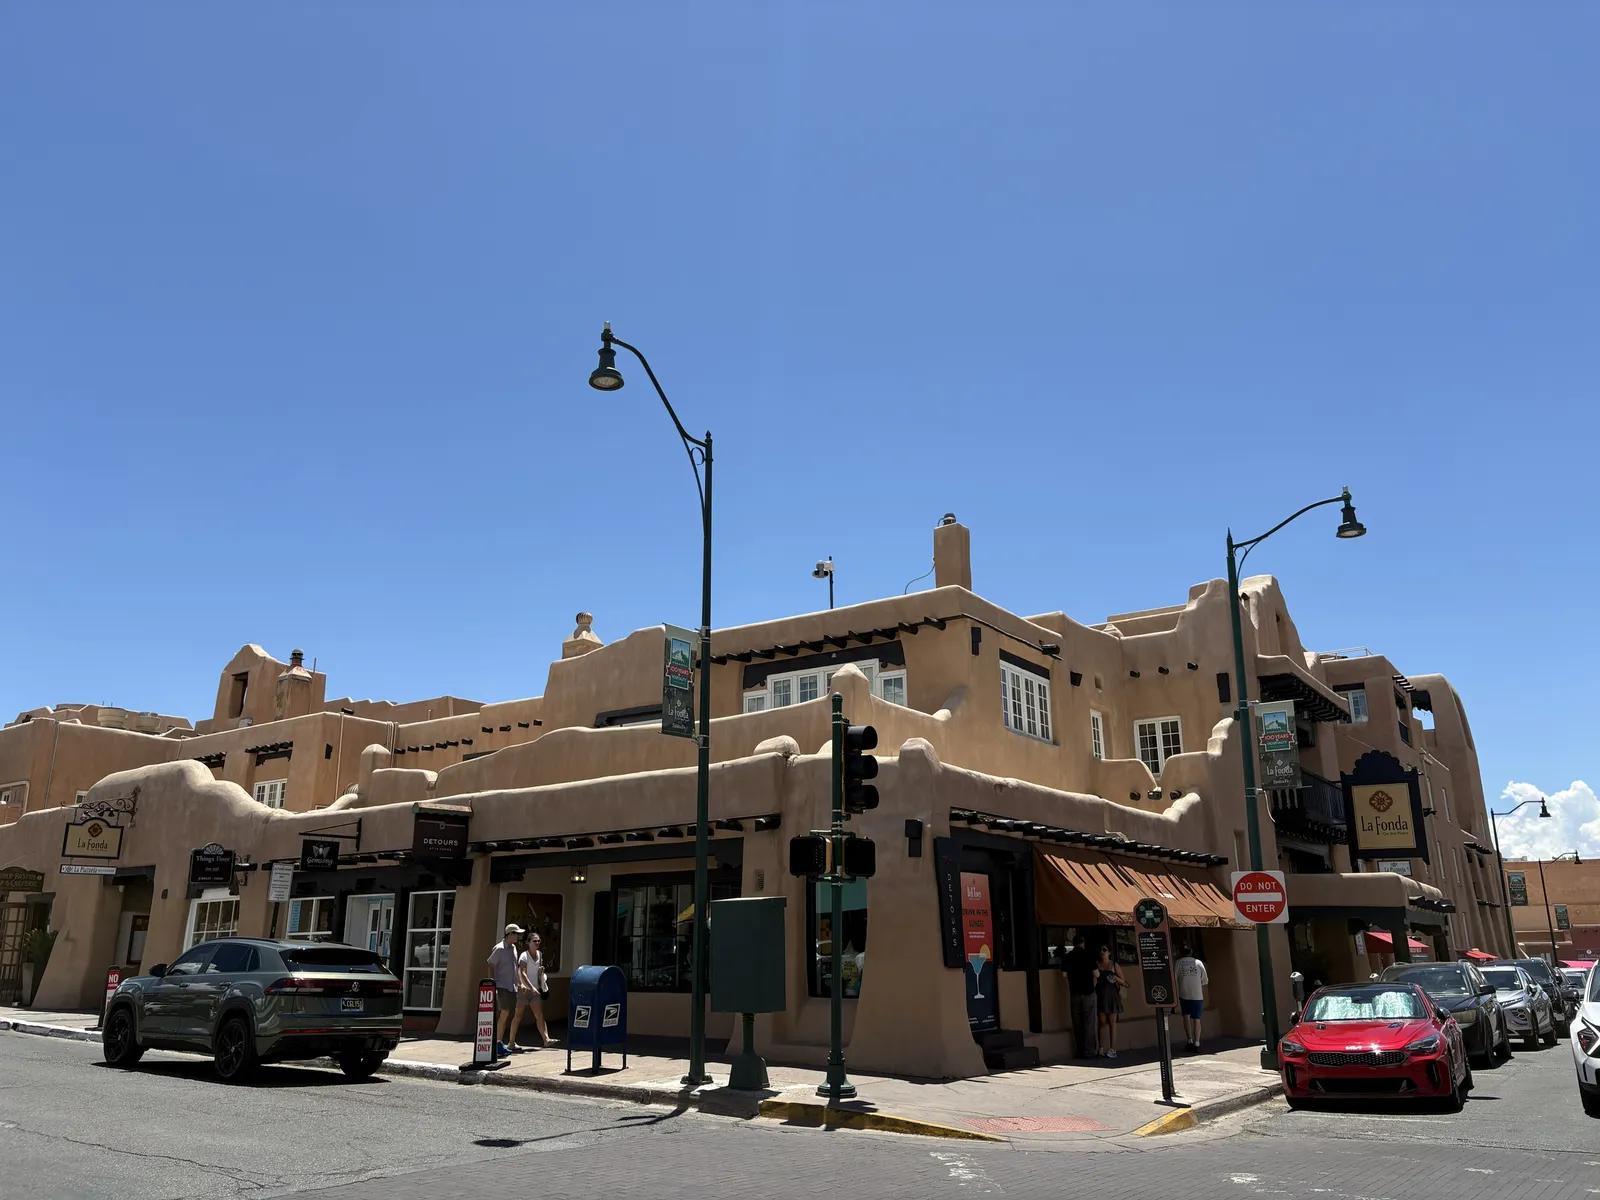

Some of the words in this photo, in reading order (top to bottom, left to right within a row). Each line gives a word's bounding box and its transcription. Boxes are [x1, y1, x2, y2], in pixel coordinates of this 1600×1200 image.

[668, 704, 674, 716] La
[1267, 766, 1274, 776] La
[1275, 765, 1293, 776] Fonda
[1361, 816, 1373, 831] La
[1375, 815, 1408, 835] Fonda
[77, 837, 86, 848] La
[87, 838, 109, 850] Fonda
[423, 838, 459, 846] DETOURS
[196, 855, 215, 863] Things
[1240, 882, 1253, 891] DO
[1258, 882, 1277, 890] NOT
[946, 873, 958, 948] DETOURS
[1246, 904, 1276, 913] ENTER
[108, 973, 119, 984] NO
[480, 990, 494, 1003] NO
[478, 1027, 492, 1037] AND
[477, 1044, 492, 1052] ONLY
